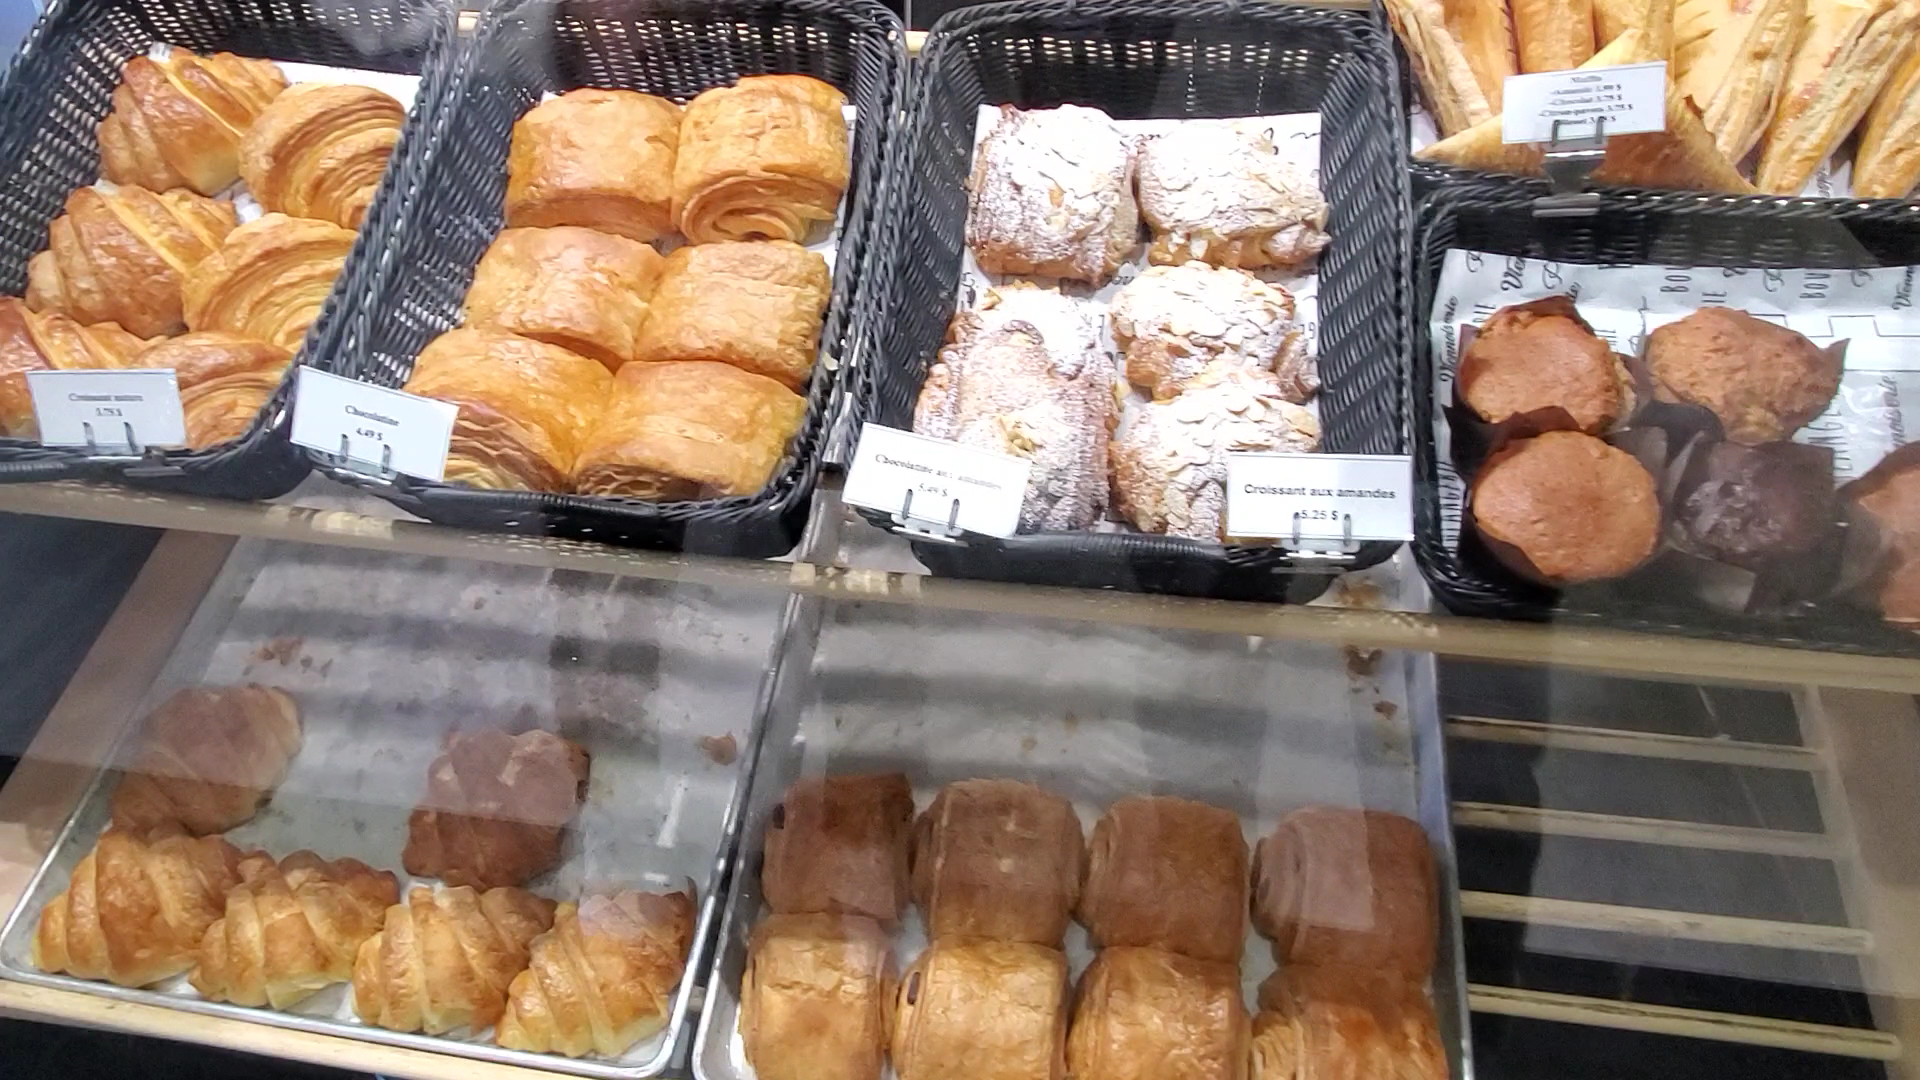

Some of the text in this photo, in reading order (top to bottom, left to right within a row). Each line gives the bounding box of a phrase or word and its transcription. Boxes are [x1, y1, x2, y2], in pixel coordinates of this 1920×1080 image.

[1244, 483, 1397, 499] Croissant aux amandes
[1299, 509, 1339, 521] 5.25 $
